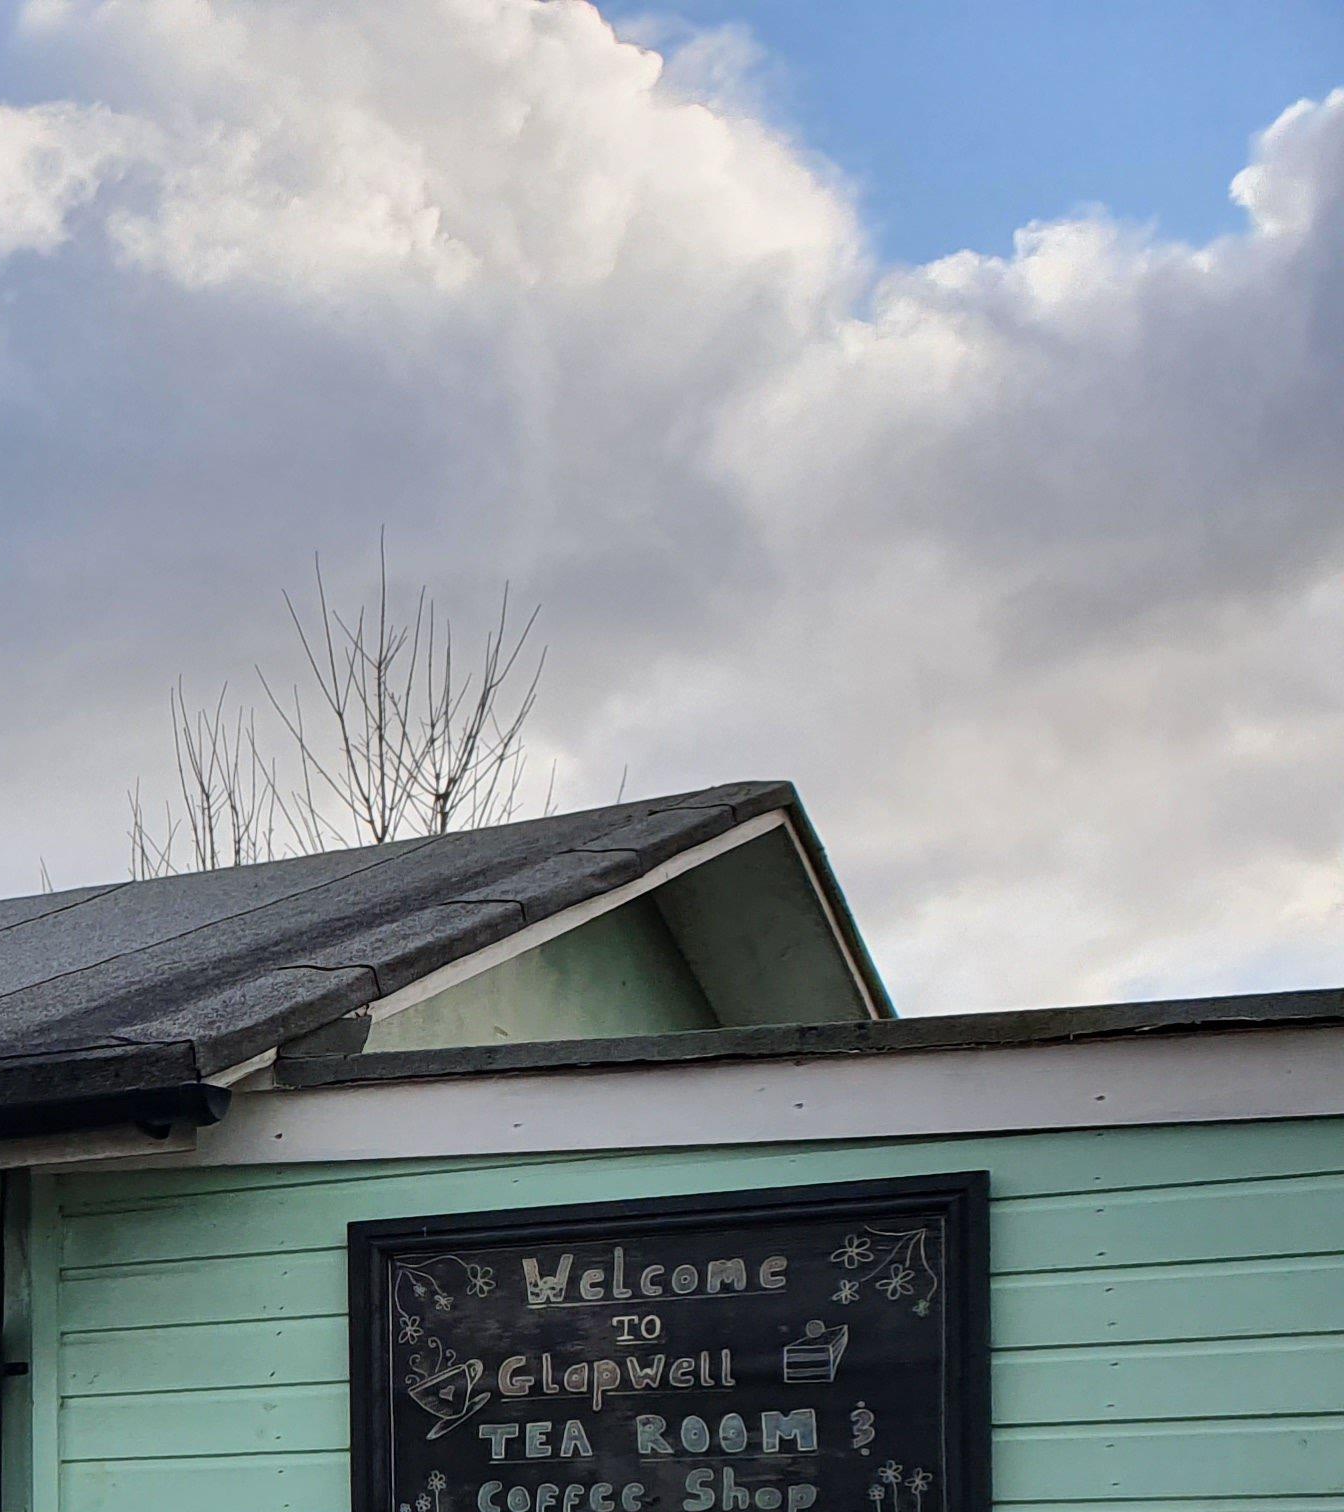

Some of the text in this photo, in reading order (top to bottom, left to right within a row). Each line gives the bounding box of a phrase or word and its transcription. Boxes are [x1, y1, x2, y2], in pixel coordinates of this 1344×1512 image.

[521, 1246, 788, 1304] Welcome
[612, 1315, 662, 1340] TO
[497, 1348, 736, 1411] Glapwell
[478, 1419, 593, 1459] TEA
[636, 1408, 818, 1454] ROOM
